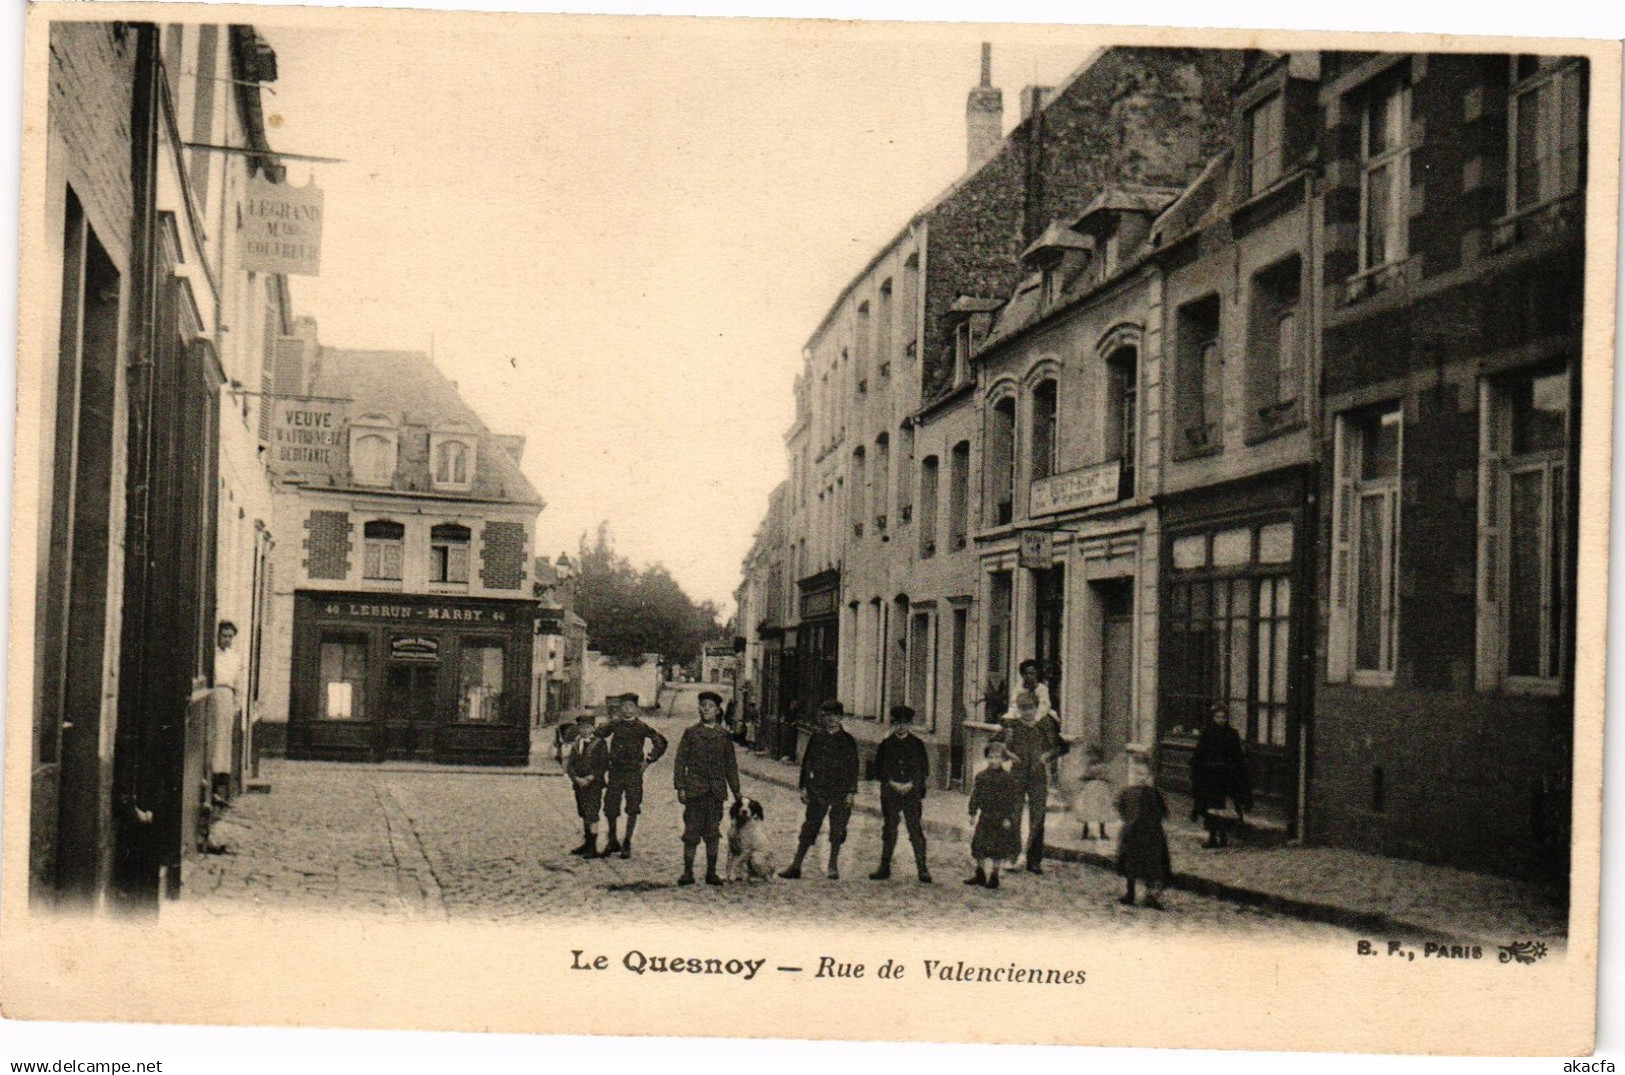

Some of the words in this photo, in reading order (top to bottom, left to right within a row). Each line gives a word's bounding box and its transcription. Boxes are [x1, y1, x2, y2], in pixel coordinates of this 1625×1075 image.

[285, 410, 332, 428] VEUVE
[349, 604, 412, 617] LEBRUN
[428, 608, 483, 621] MARBY
